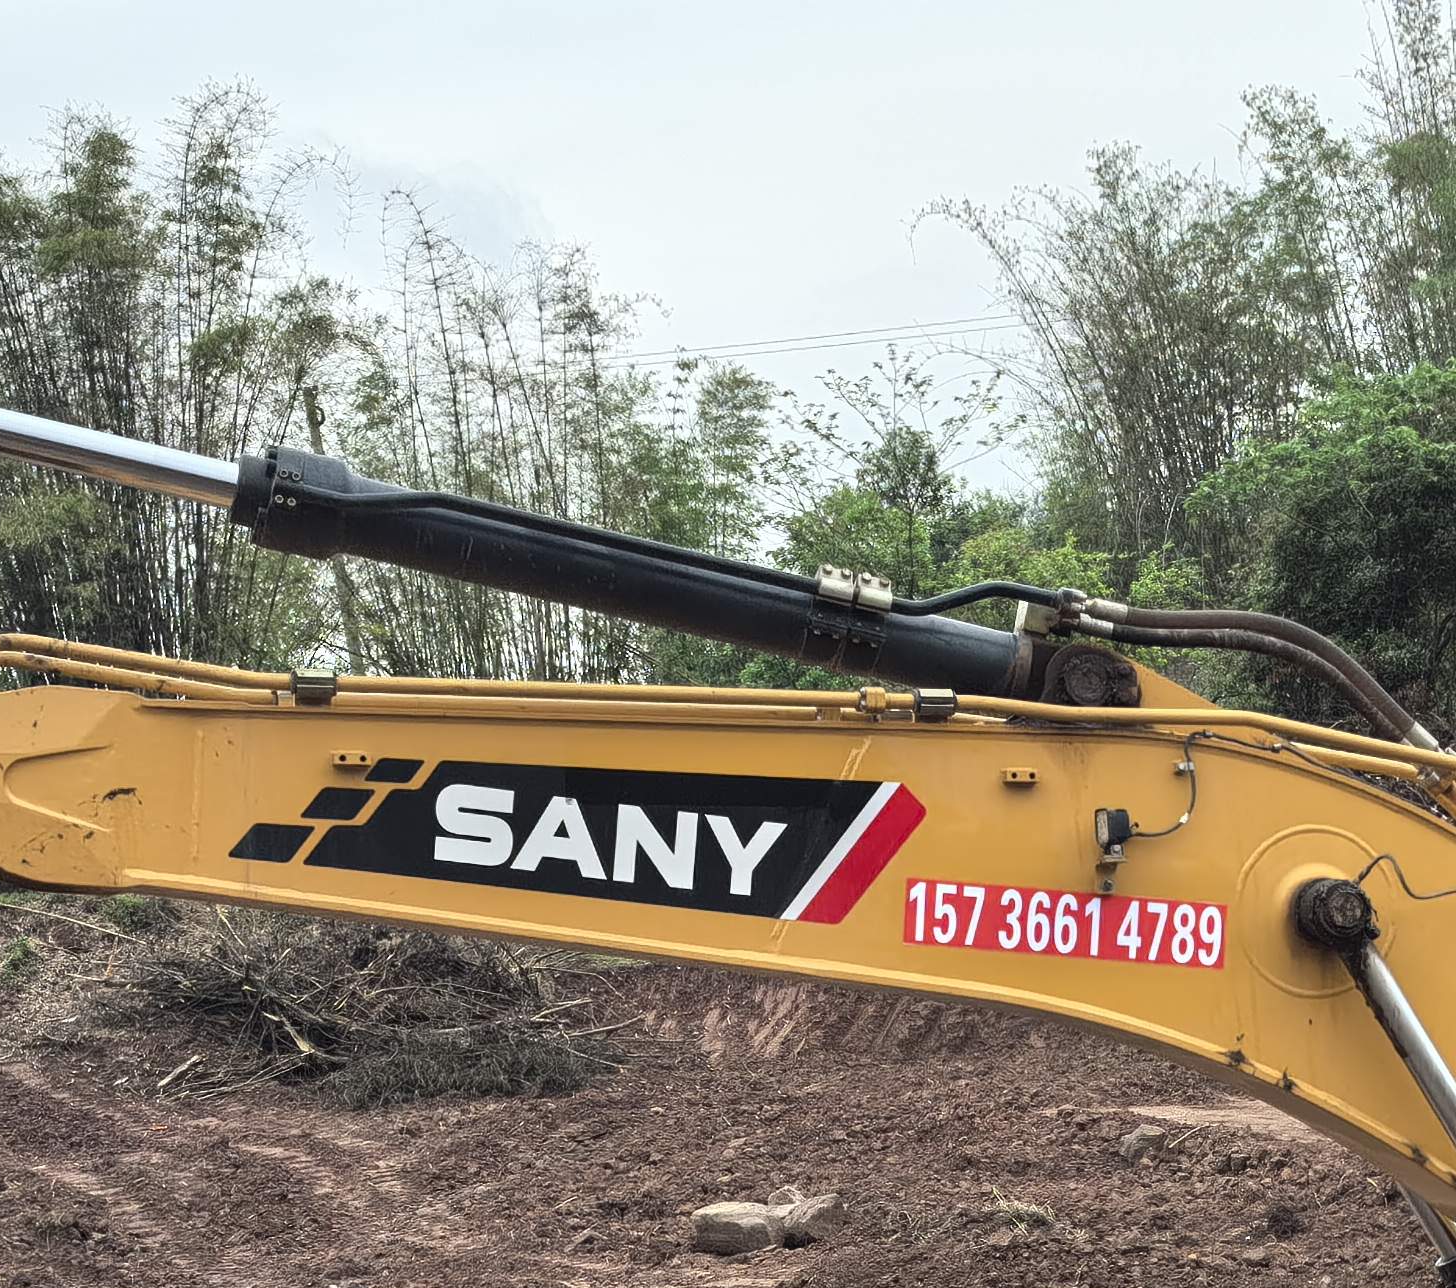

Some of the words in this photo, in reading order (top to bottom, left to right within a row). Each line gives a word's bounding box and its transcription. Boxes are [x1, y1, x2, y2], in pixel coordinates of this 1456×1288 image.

[434, 783, 788, 896] SANY
[909, 881, 985, 945] 157
[997, 888, 1101, 956] 3661
[1117, 900, 1222, 966] 4789
